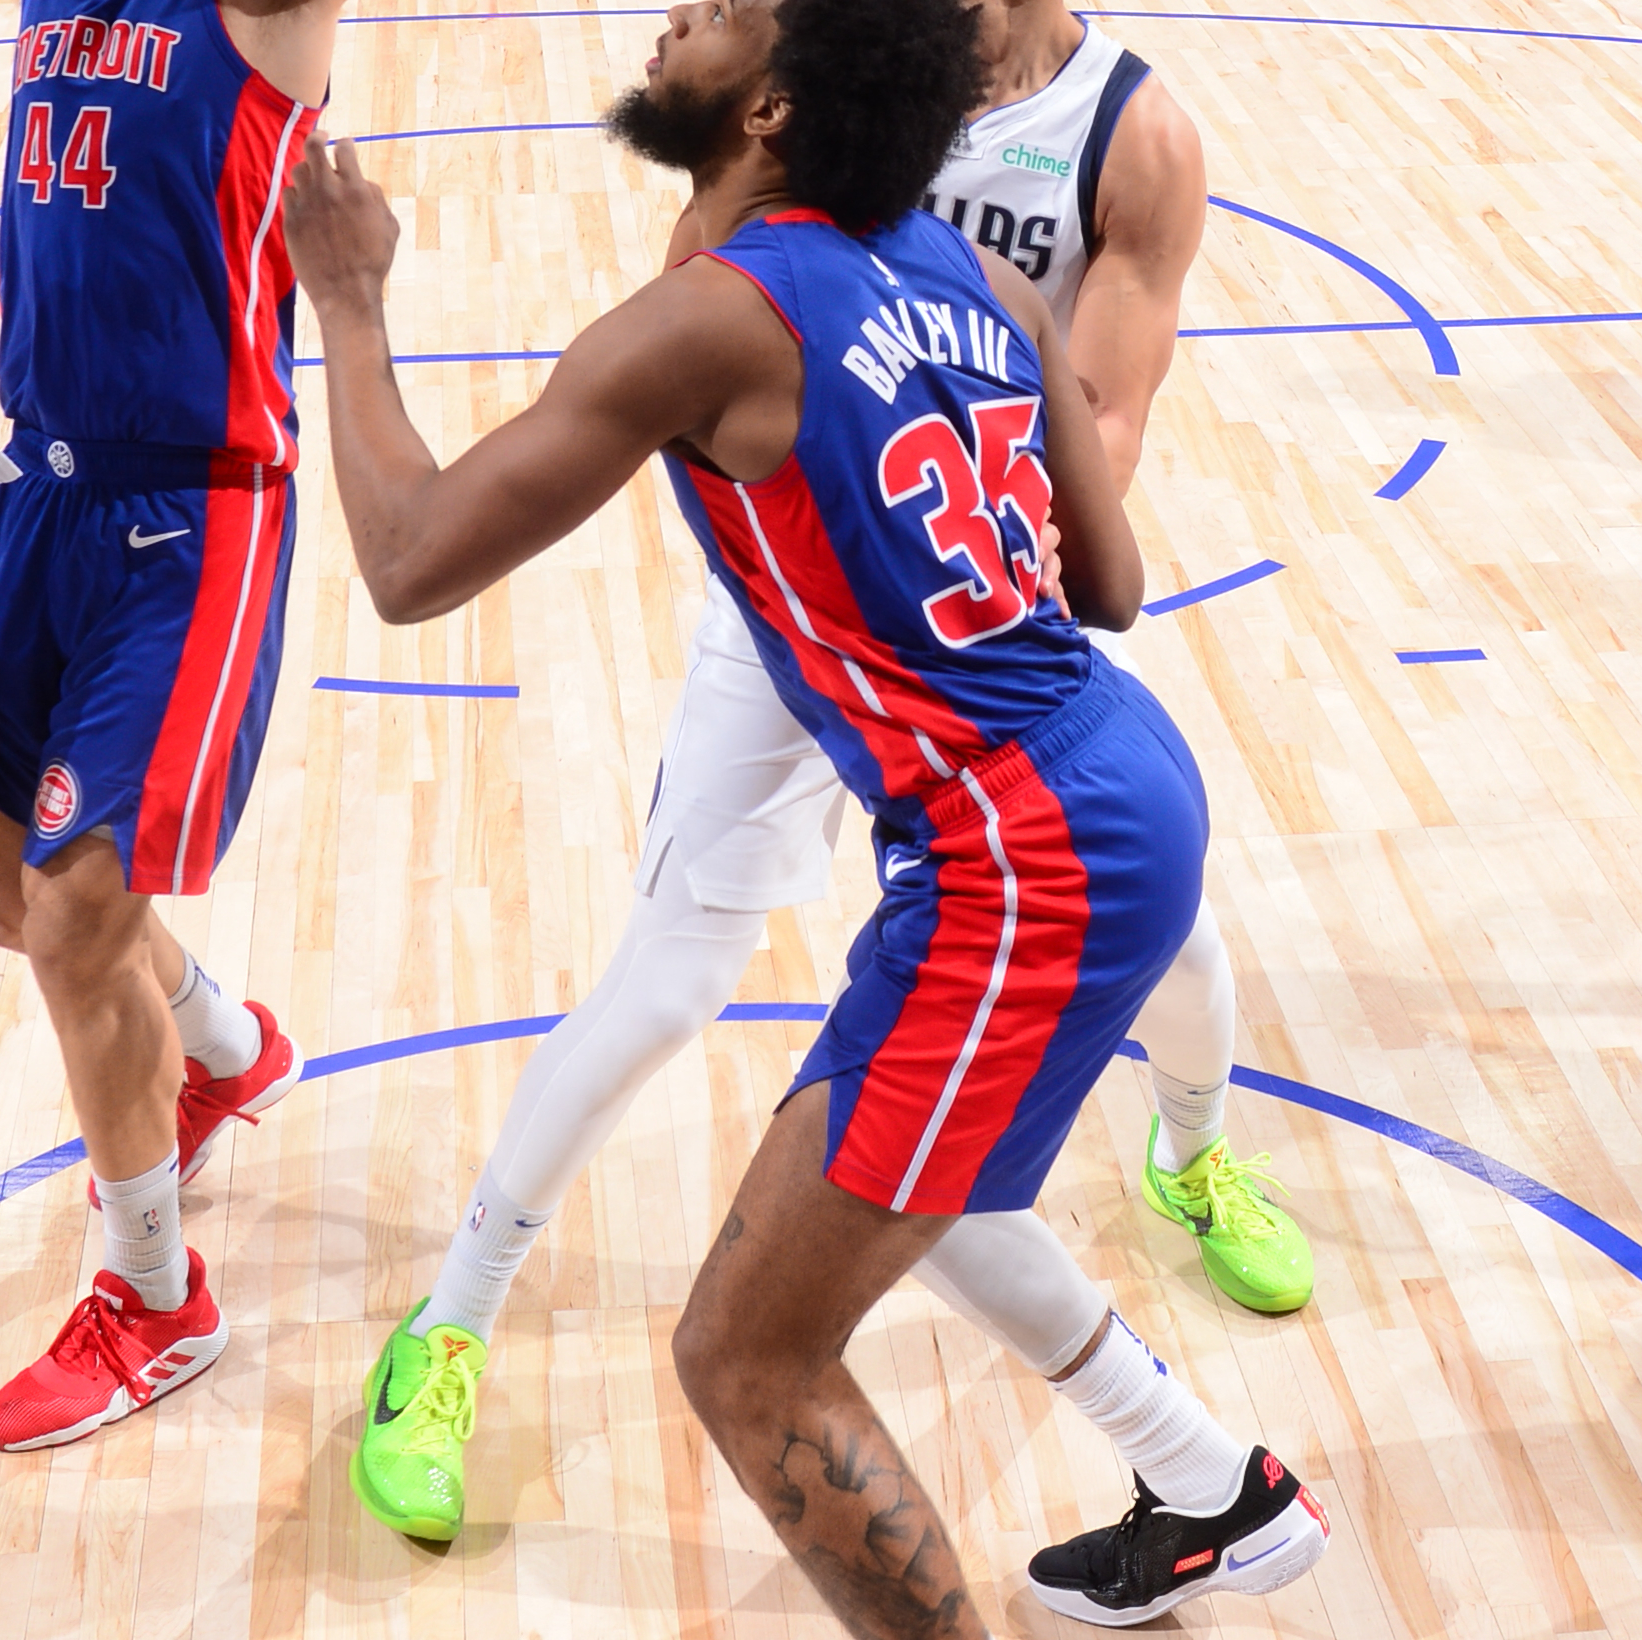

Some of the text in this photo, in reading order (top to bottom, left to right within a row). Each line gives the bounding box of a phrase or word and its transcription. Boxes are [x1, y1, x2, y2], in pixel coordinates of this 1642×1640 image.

[13, 14, 183, 94] DETROIT
[17, 101, 117, 210] 44
[1001, 143, 1072, 178] chime
[841, 297, 1011, 406] BAGLEY III
[877, 394, 1054, 650] 35
